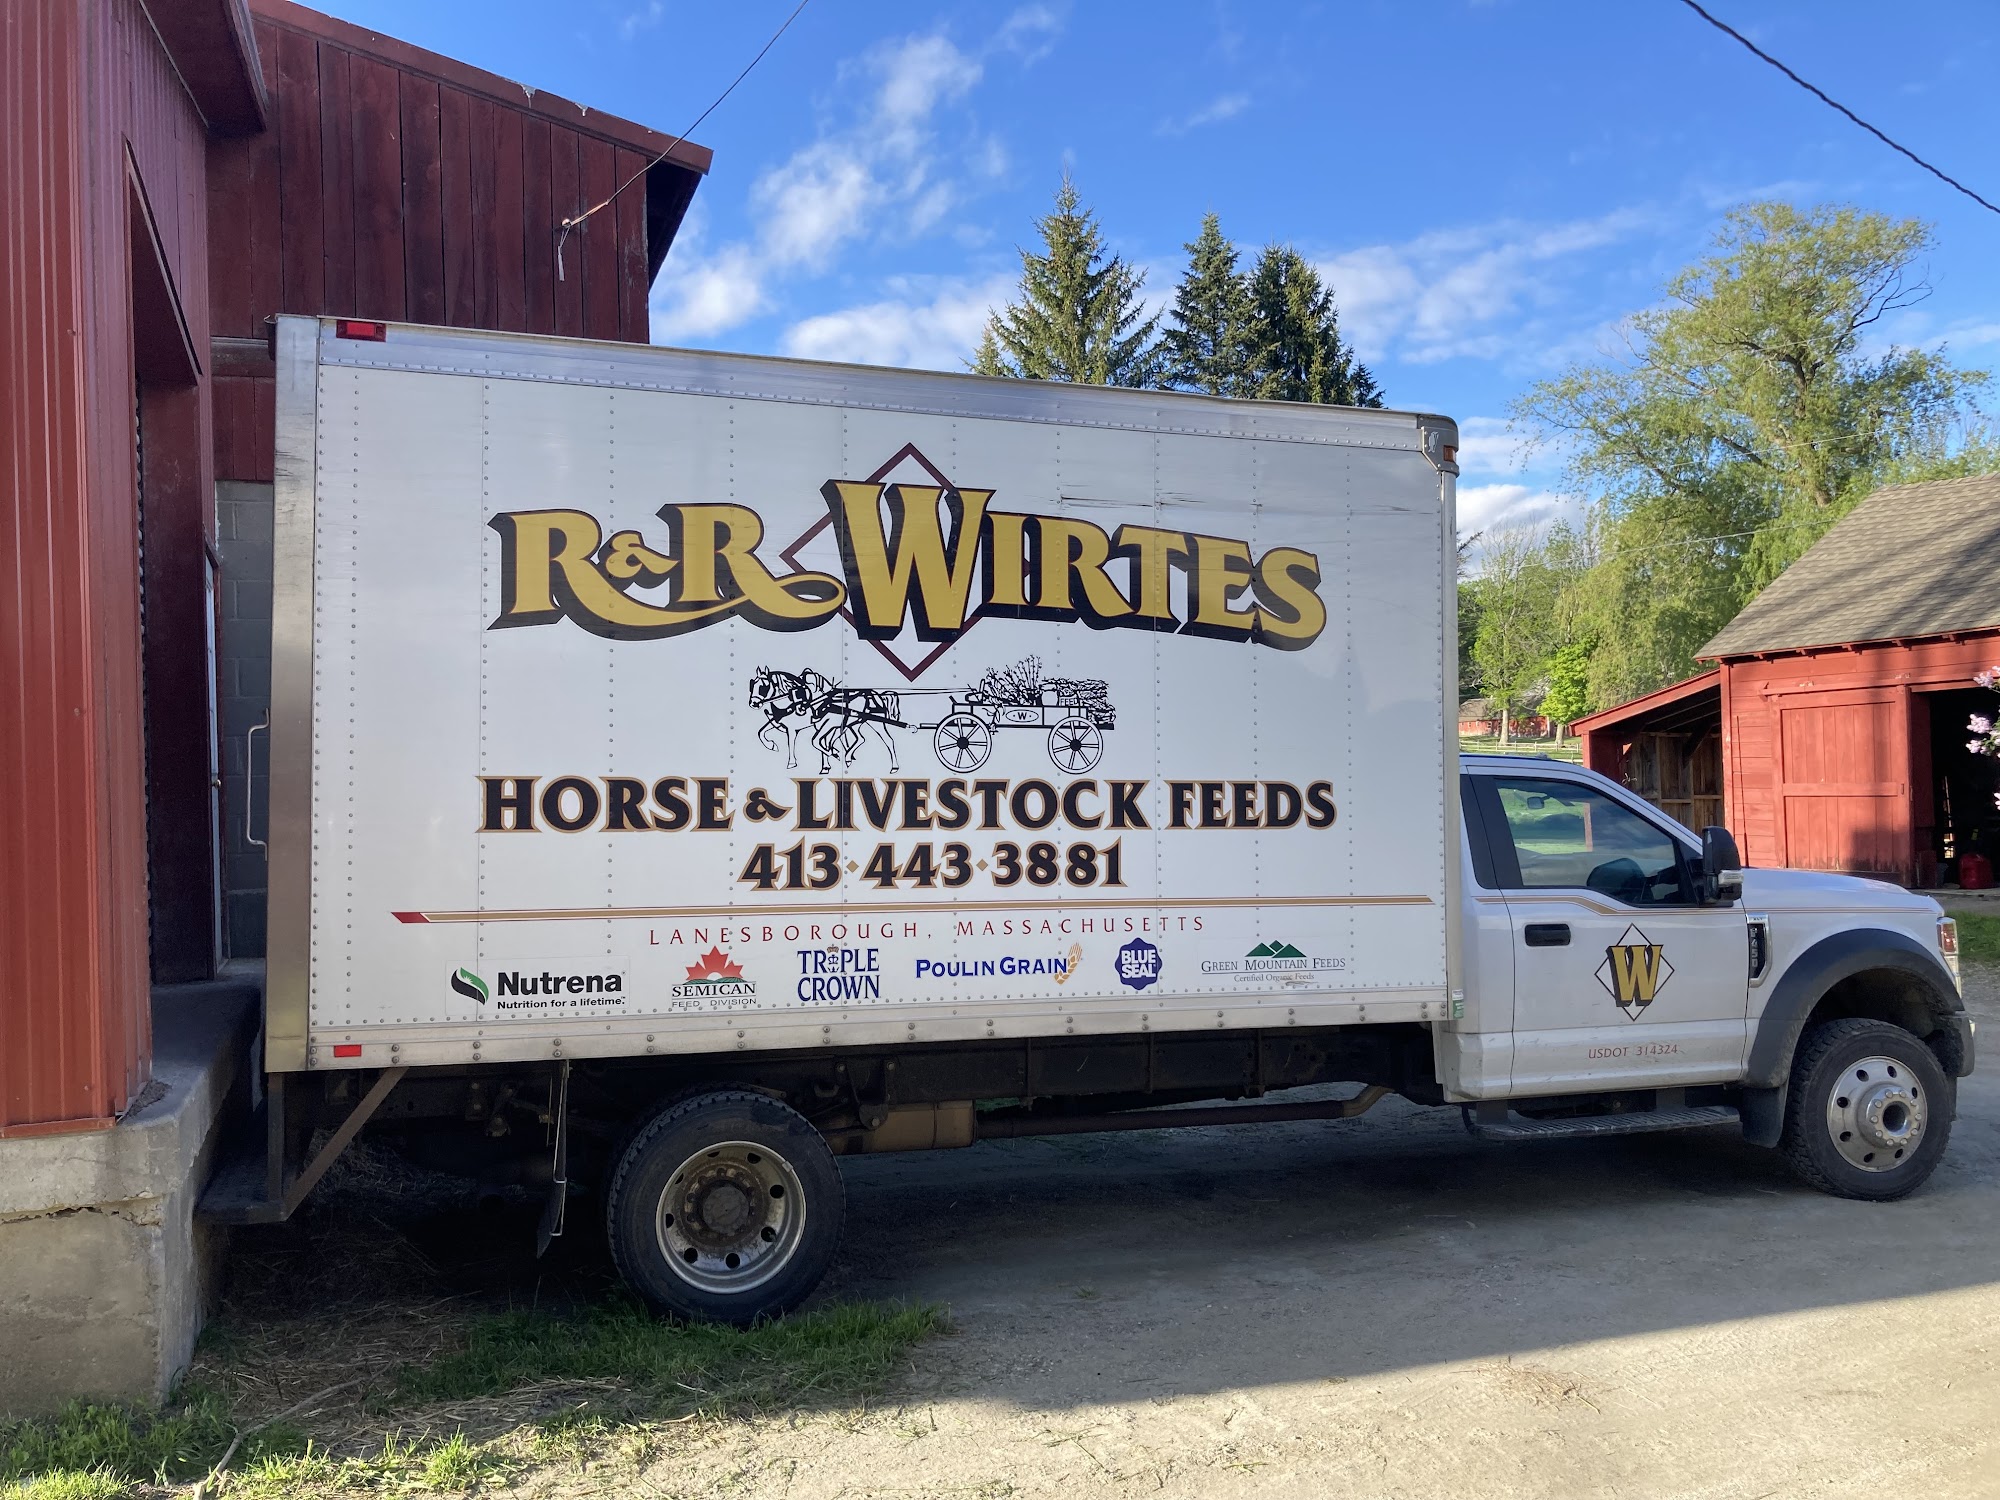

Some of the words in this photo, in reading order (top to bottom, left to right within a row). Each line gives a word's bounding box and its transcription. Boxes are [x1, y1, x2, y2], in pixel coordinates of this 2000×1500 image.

[486, 502, 847, 642] R&R
[820, 479, 1327, 651] WIRTES
[475, 775, 736, 834] HORSE
[743, 787, 792, 823] &
[790, 777, 1152, 833] LIVESTOCK
[1164, 779, 1337, 831] FEEDS
[649, 919, 932, 946] LANESBOROUGH,
[957, 916, 1204, 937] MASSACHUSETTS
[1120, 949, 1156, 965] BLUE
[1200, 960, 1239, 973] GREEN
[1244, 958, 1308, 971] MOUNTAIN
[1312, 957, 1346, 970] FEEDS
[915, 956, 995, 979] POULIN
[1000, 955, 1068, 977] GRAIN
[1120, 963, 1158, 979] SEAL
[497, 971, 622, 996] Nutrena
[1233, 973, 1264, 983] Certified
[1295, 972, 1315, 981] Feeds
[1606, 943, 1664, 1008] W
[671, 983, 756, 998] SEMICAN
[797, 974, 880, 1002] CROWN
[497, 999, 547, 1010] Nutrition
[550, 999, 567, 1008] for
[671, 1000, 700, 1009] FEED
[709, 997, 757, 1007] DIVISION
[1588, 1046, 1629, 1060] USDOT
[1635, 1044, 1678, 1057] 314324
